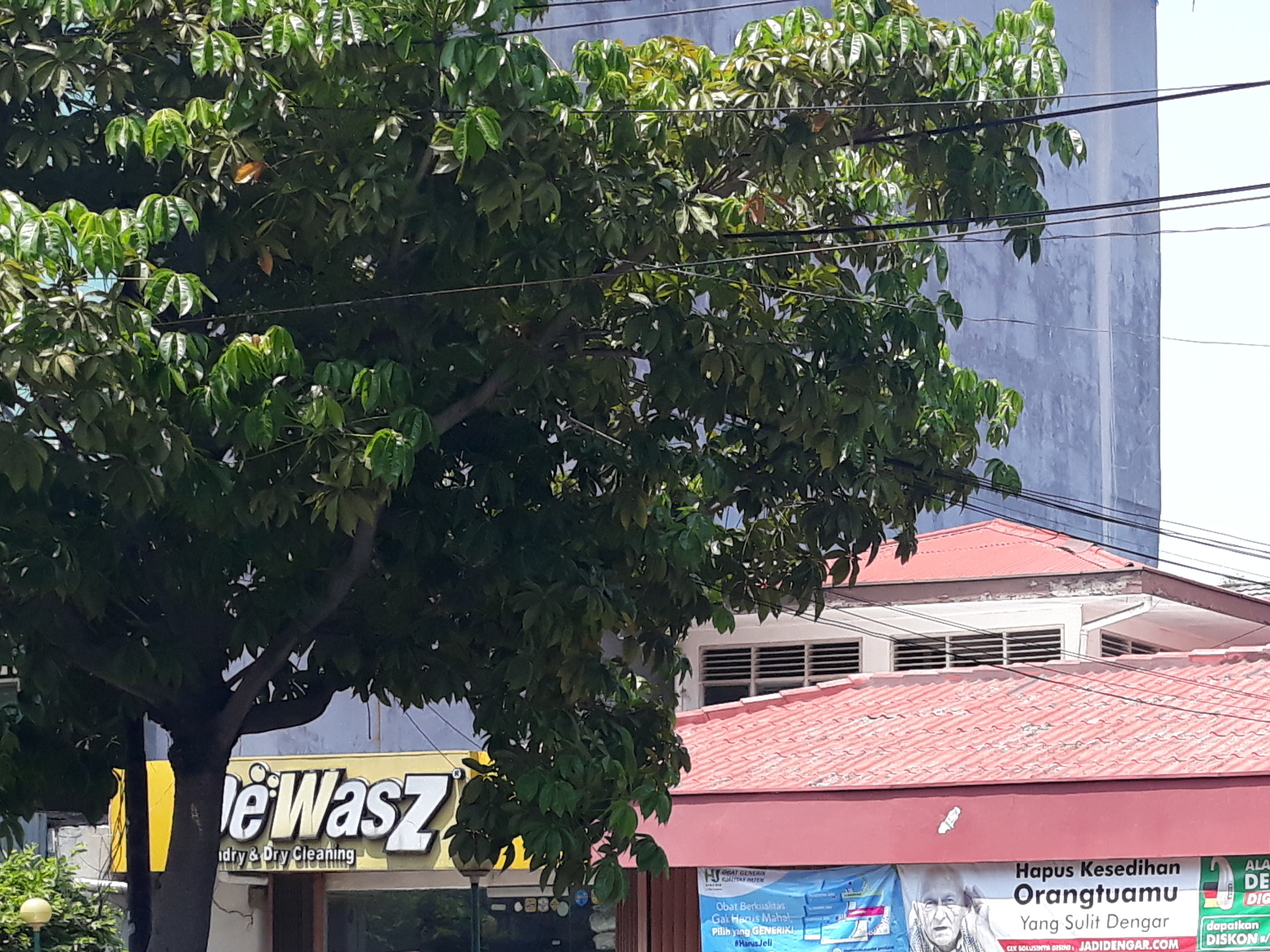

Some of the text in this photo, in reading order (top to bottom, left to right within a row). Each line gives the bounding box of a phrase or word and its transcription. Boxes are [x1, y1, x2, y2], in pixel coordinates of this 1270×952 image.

[249, 848, 259, 862] &
[263, 847, 288, 865] Dry
[292, 845, 356, 865] Cleaning
[1016, 859, 1180, 882] Hapus Kesedihan
[1014, 883, 1178, 909] Orangtuamu
[1020, 913, 1169, 934] Yang Sulit Dengar
[1206, 919, 1260, 932] dapatkan
[1079, 939, 1179, 952] JADIDENGAR.COM
[1206, 933, 1258, 946] DISKON
